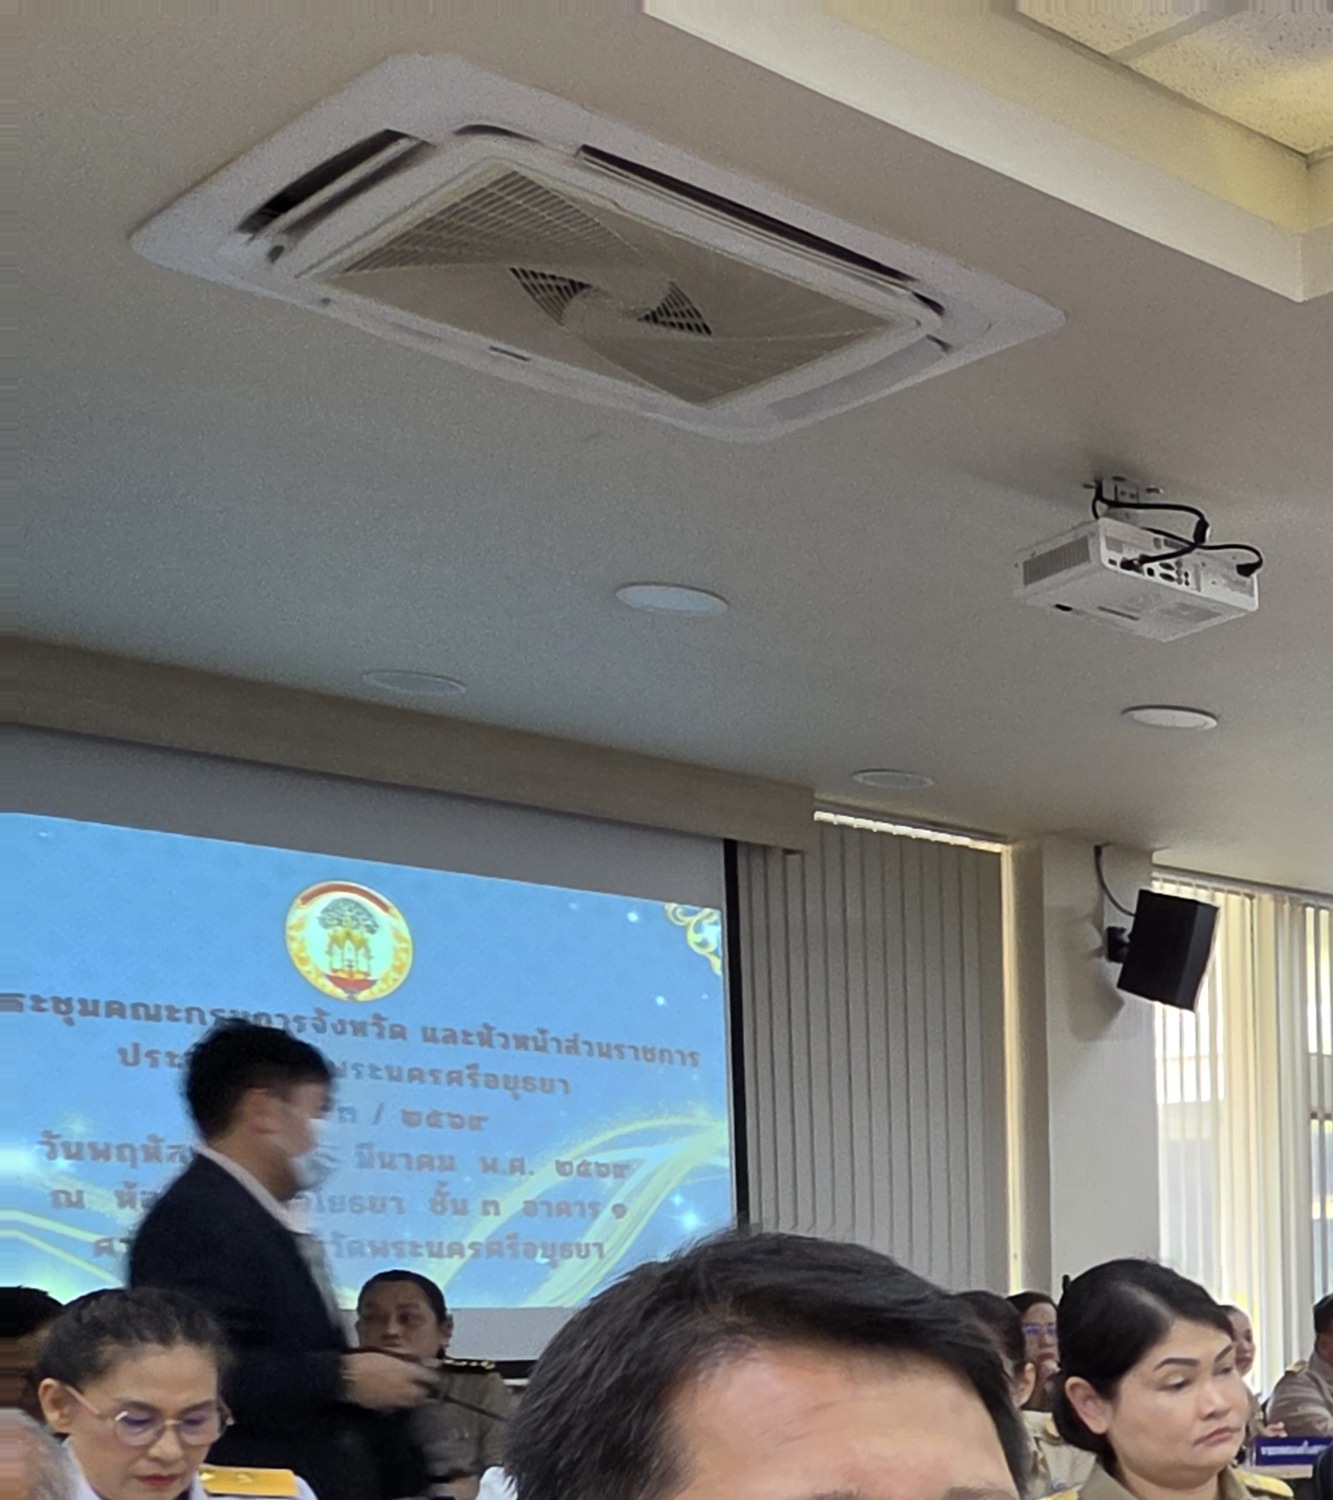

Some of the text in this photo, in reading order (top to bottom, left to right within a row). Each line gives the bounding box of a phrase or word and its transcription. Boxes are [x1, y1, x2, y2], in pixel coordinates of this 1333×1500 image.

[421, 1022, 700, 1068] และหัวหน้าส่วนราชการ
[356, 1143, 456, 1173] มีนาคม
[480, 1153, 535, 1177] พ.ศ.
[51, 1190, 85, 1210] ณ
[428, 1181, 470, 1217] ชั้น
[522, 1199, 602, 1220] อาคาร
[611, 1202, 628, 1221] ๑
